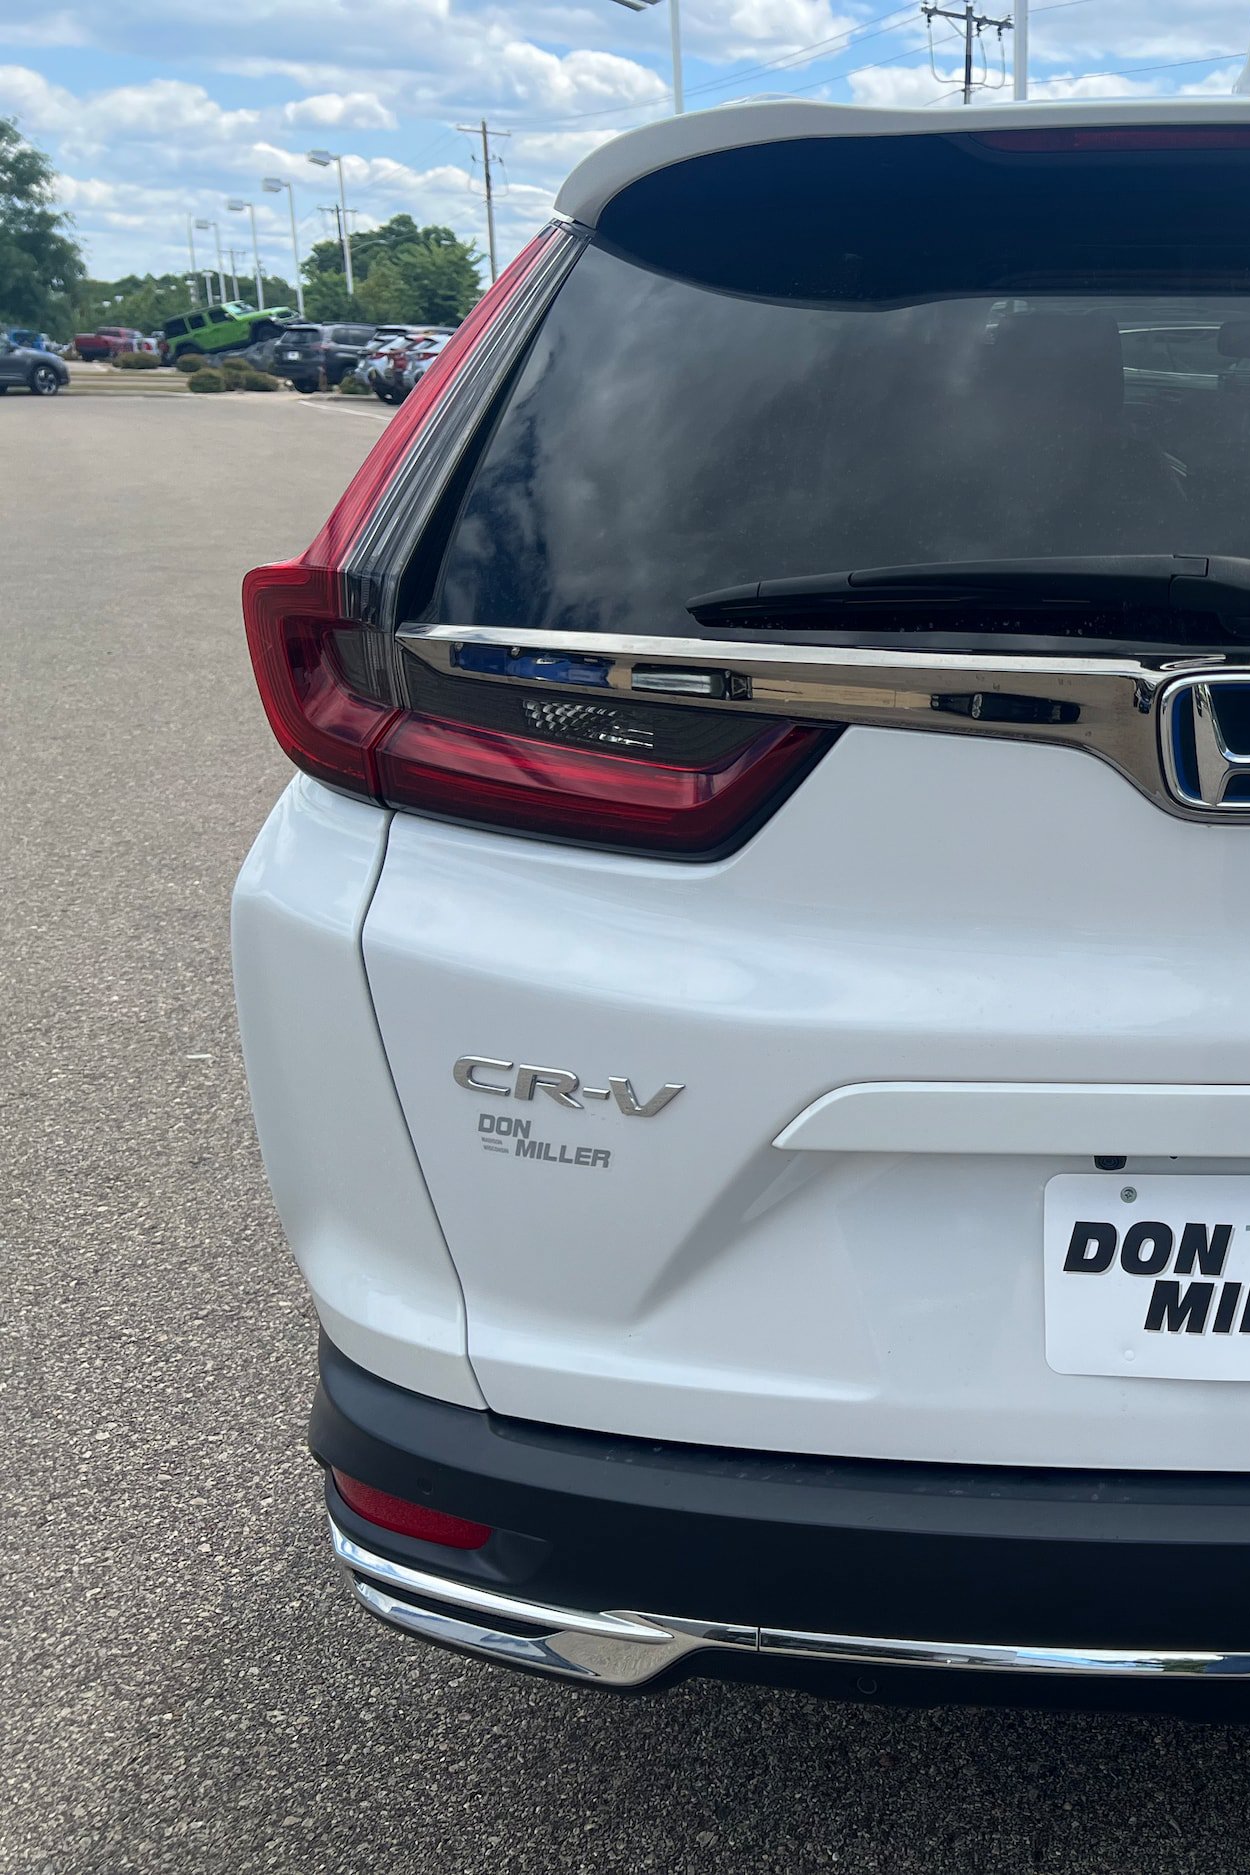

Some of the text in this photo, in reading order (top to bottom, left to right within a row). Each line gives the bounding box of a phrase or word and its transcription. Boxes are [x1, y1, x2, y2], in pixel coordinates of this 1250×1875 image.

[453, 1055, 686, 1117] CR-V
[478, 1113, 531, 1139] DON
[515, 1139, 611, 1168] MILLER
[1063, 1221, 1234, 1276] DON
